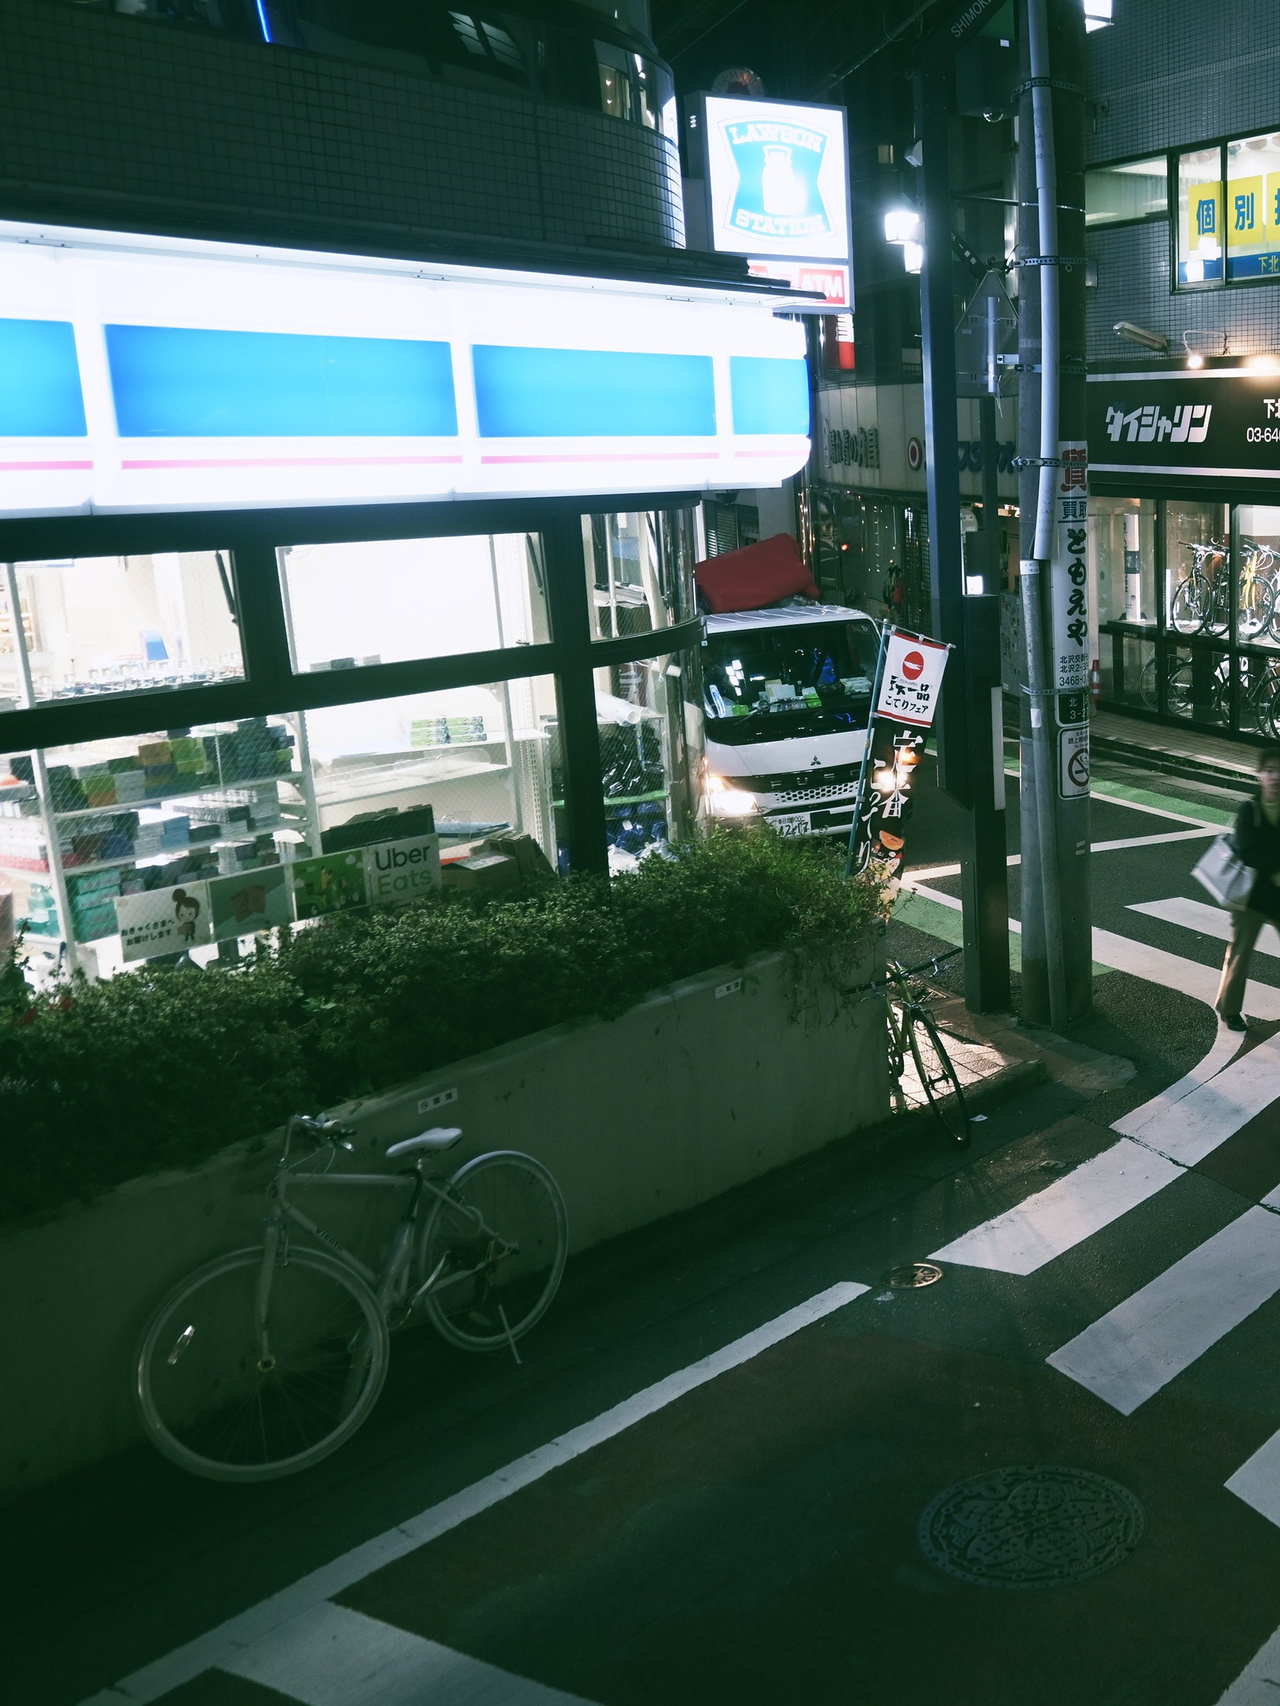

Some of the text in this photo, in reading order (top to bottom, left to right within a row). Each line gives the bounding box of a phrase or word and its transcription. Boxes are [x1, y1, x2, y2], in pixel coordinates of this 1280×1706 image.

[950, 0, 992, 38] SHIMOK
[728, 123, 824, 153] LAWSON
[735, 208, 827, 236] STATION
[799, 273, 844, 299] ATM
[375, 844, 431, 872] Uber
[377, 868, 433, 894] Eats
